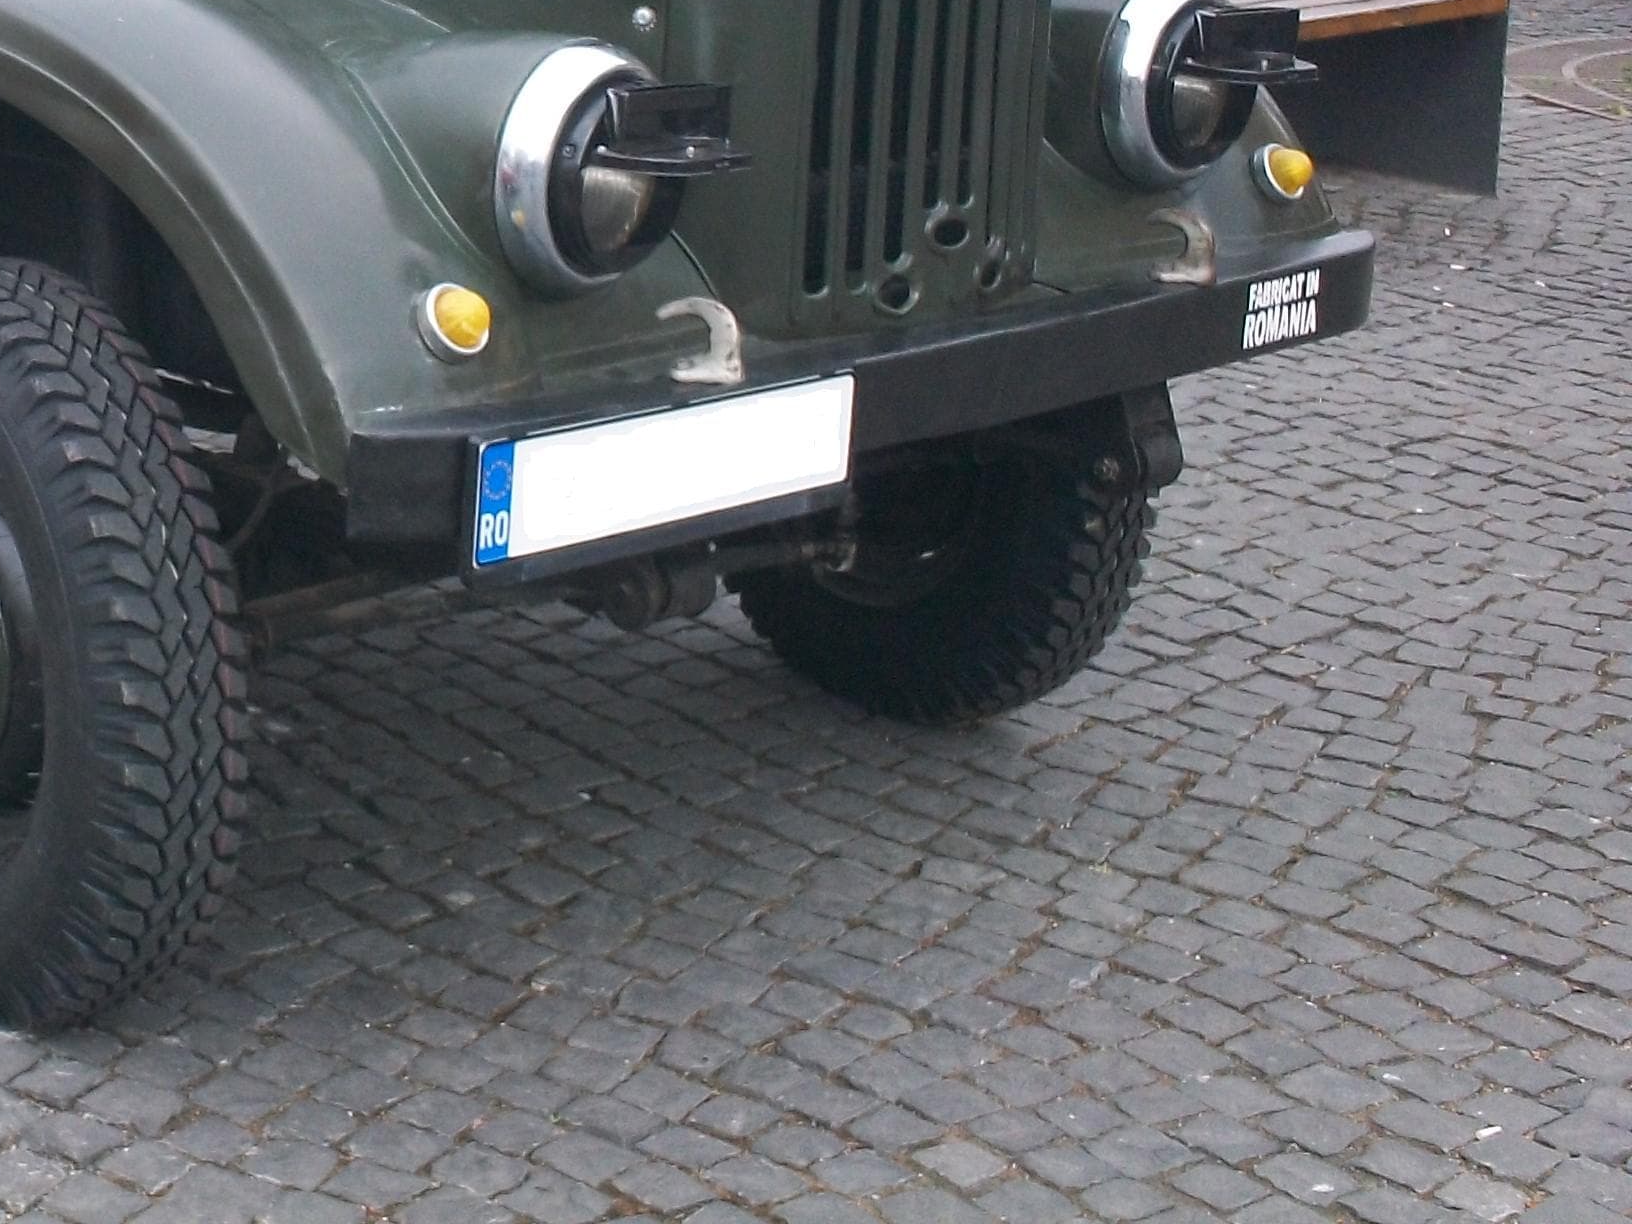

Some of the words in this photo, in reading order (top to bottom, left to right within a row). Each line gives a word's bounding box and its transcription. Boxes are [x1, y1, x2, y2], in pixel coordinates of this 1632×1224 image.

[1248, 272, 1305, 312] FABRICAT
[1305, 268, 1320, 298] IN
[1242, 298, 1317, 350] ROMANIA
[479, 510, 509, 550] RO
